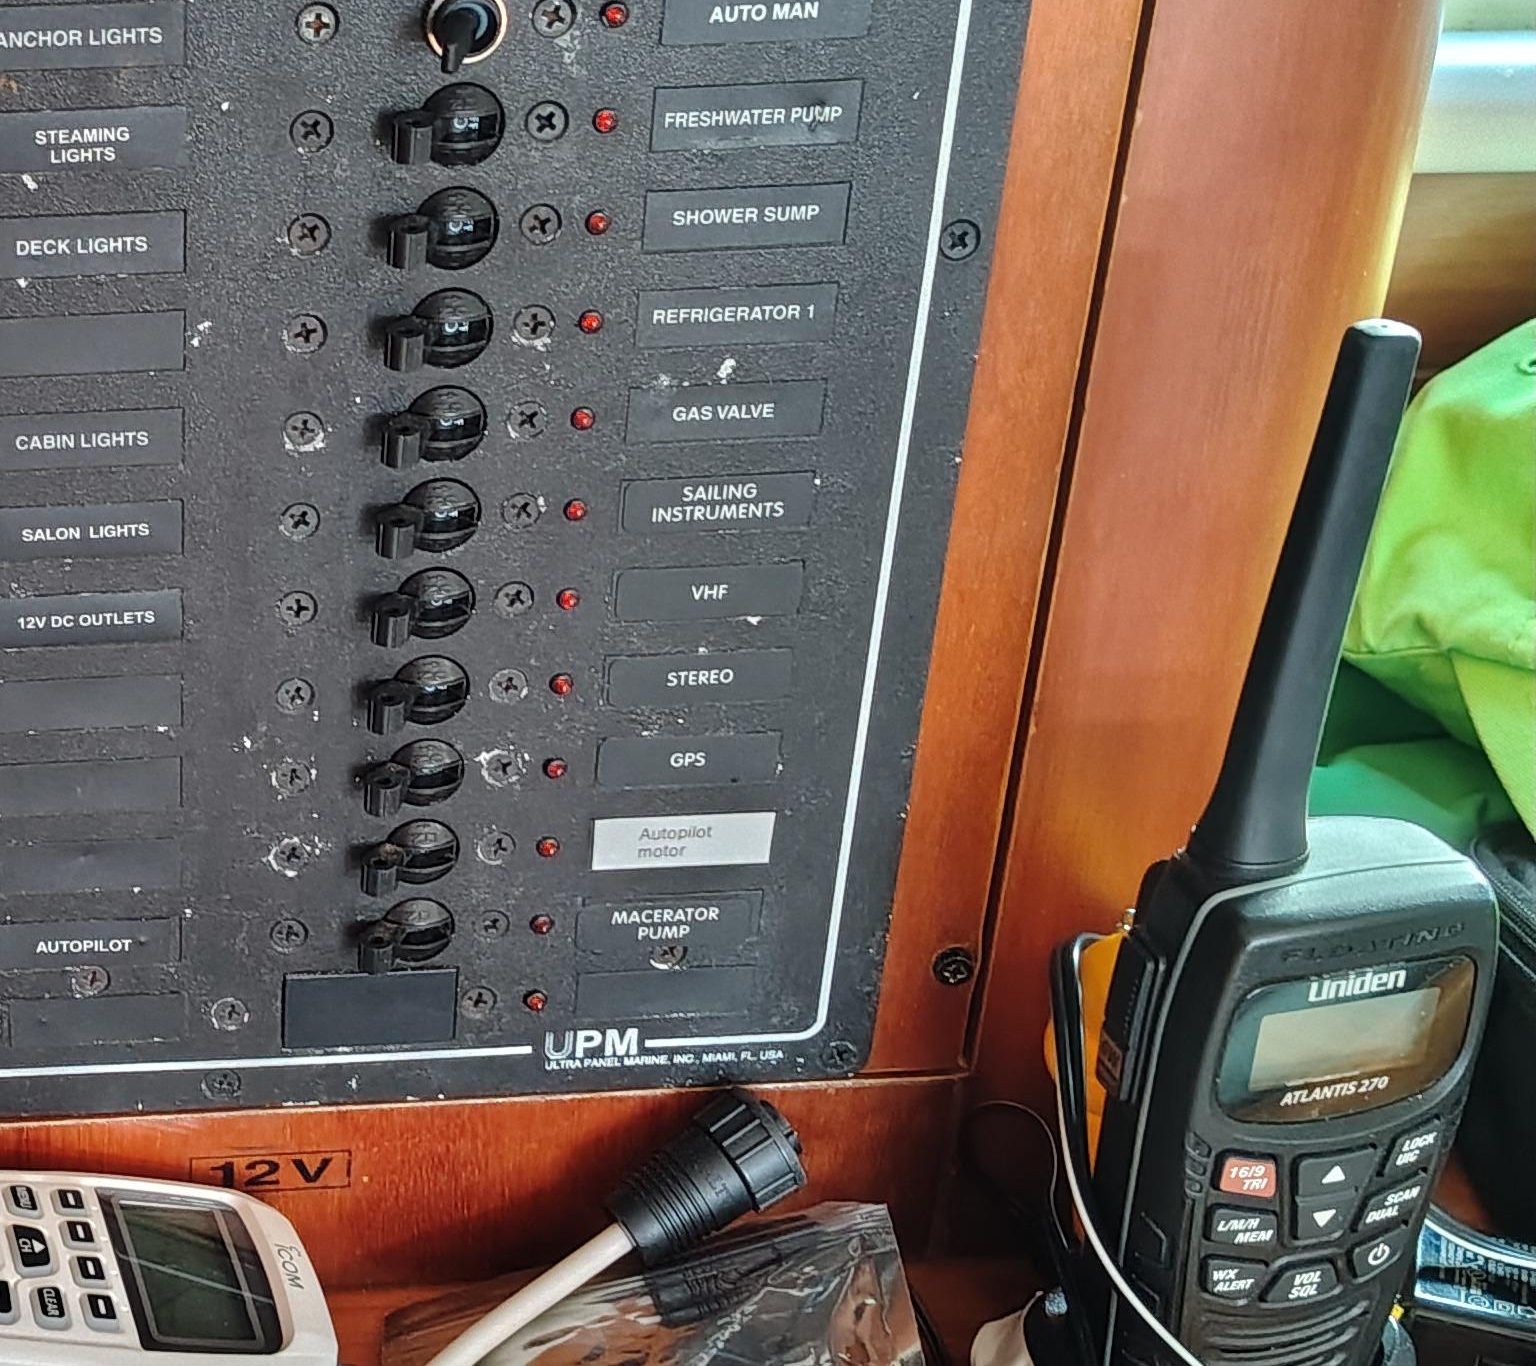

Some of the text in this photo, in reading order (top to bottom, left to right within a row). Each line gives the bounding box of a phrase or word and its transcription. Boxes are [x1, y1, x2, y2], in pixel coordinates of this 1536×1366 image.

[709, 1, 819, 23] AUTO MAN
[89, 27, 162, 45] LIGHTS
[665, 104, 843, 128] FRESHWATER PUMP
[35, 127, 130, 145] STEAMING
[50, 146, 115, 163] LIGHTS
[673, 203, 819, 226] SHOWER SUMP
[16, 236, 148, 256] DECK LIGHTS
[653, 305, 814, 325] REFRIGERATOR 1
[673, 402, 775, 422] GAS VALVE
[15, 430, 148, 450] CABIN LIGHTS
[682, 483, 757, 502] SAILING
[652, 502, 784, 522] INSTRUMENTS
[22, 522, 149, 542] SALON LIGHTS
[691, 584, 729, 601] VHF
[17, 610, 155, 630] 12V DC OUTLETS
[666, 668, 733, 686] STEREO
[670, 751, 705, 768] GPS
[639, 825, 713, 841] Autopilot
[638, 845, 687, 858] motor
[611, 907, 720, 925] MACERATOR
[637, 925, 690, 940] PUMP
[36, 938, 132, 954] AUTOPILOT
[1308, 969, 1406, 1002] Uniden
[544, 1028, 639, 1059] UPM
[546, 1058, 582, 1070] ULTRA
[584, 1057, 620, 1067] PANEL
[760, 1050, 783, 1060] USA
[1280, 1076, 1389, 1106] ATLANTIS 270
[1402, 1132, 1437, 1151] LOCK
[1230, 1165, 1265, 1178] 16/9
[1242, 1179, 1268, 1189] TRI
[1385, 1186, 1420, 1205] SCAN
[1365, 1205, 1398, 1224] DUAL
[19, 1238, 33, 1253] CH
[1234, 1230, 1273, 1244] MEM
[1212, 1269, 1239, 1280] WX
[1294, 1271, 1322, 1285] VOL
[1214, 1279, 1254, 1292] ALERT
[1289, 1285, 1318, 1299] SQL
[43, 1288, 59, 1316] CLEAR
